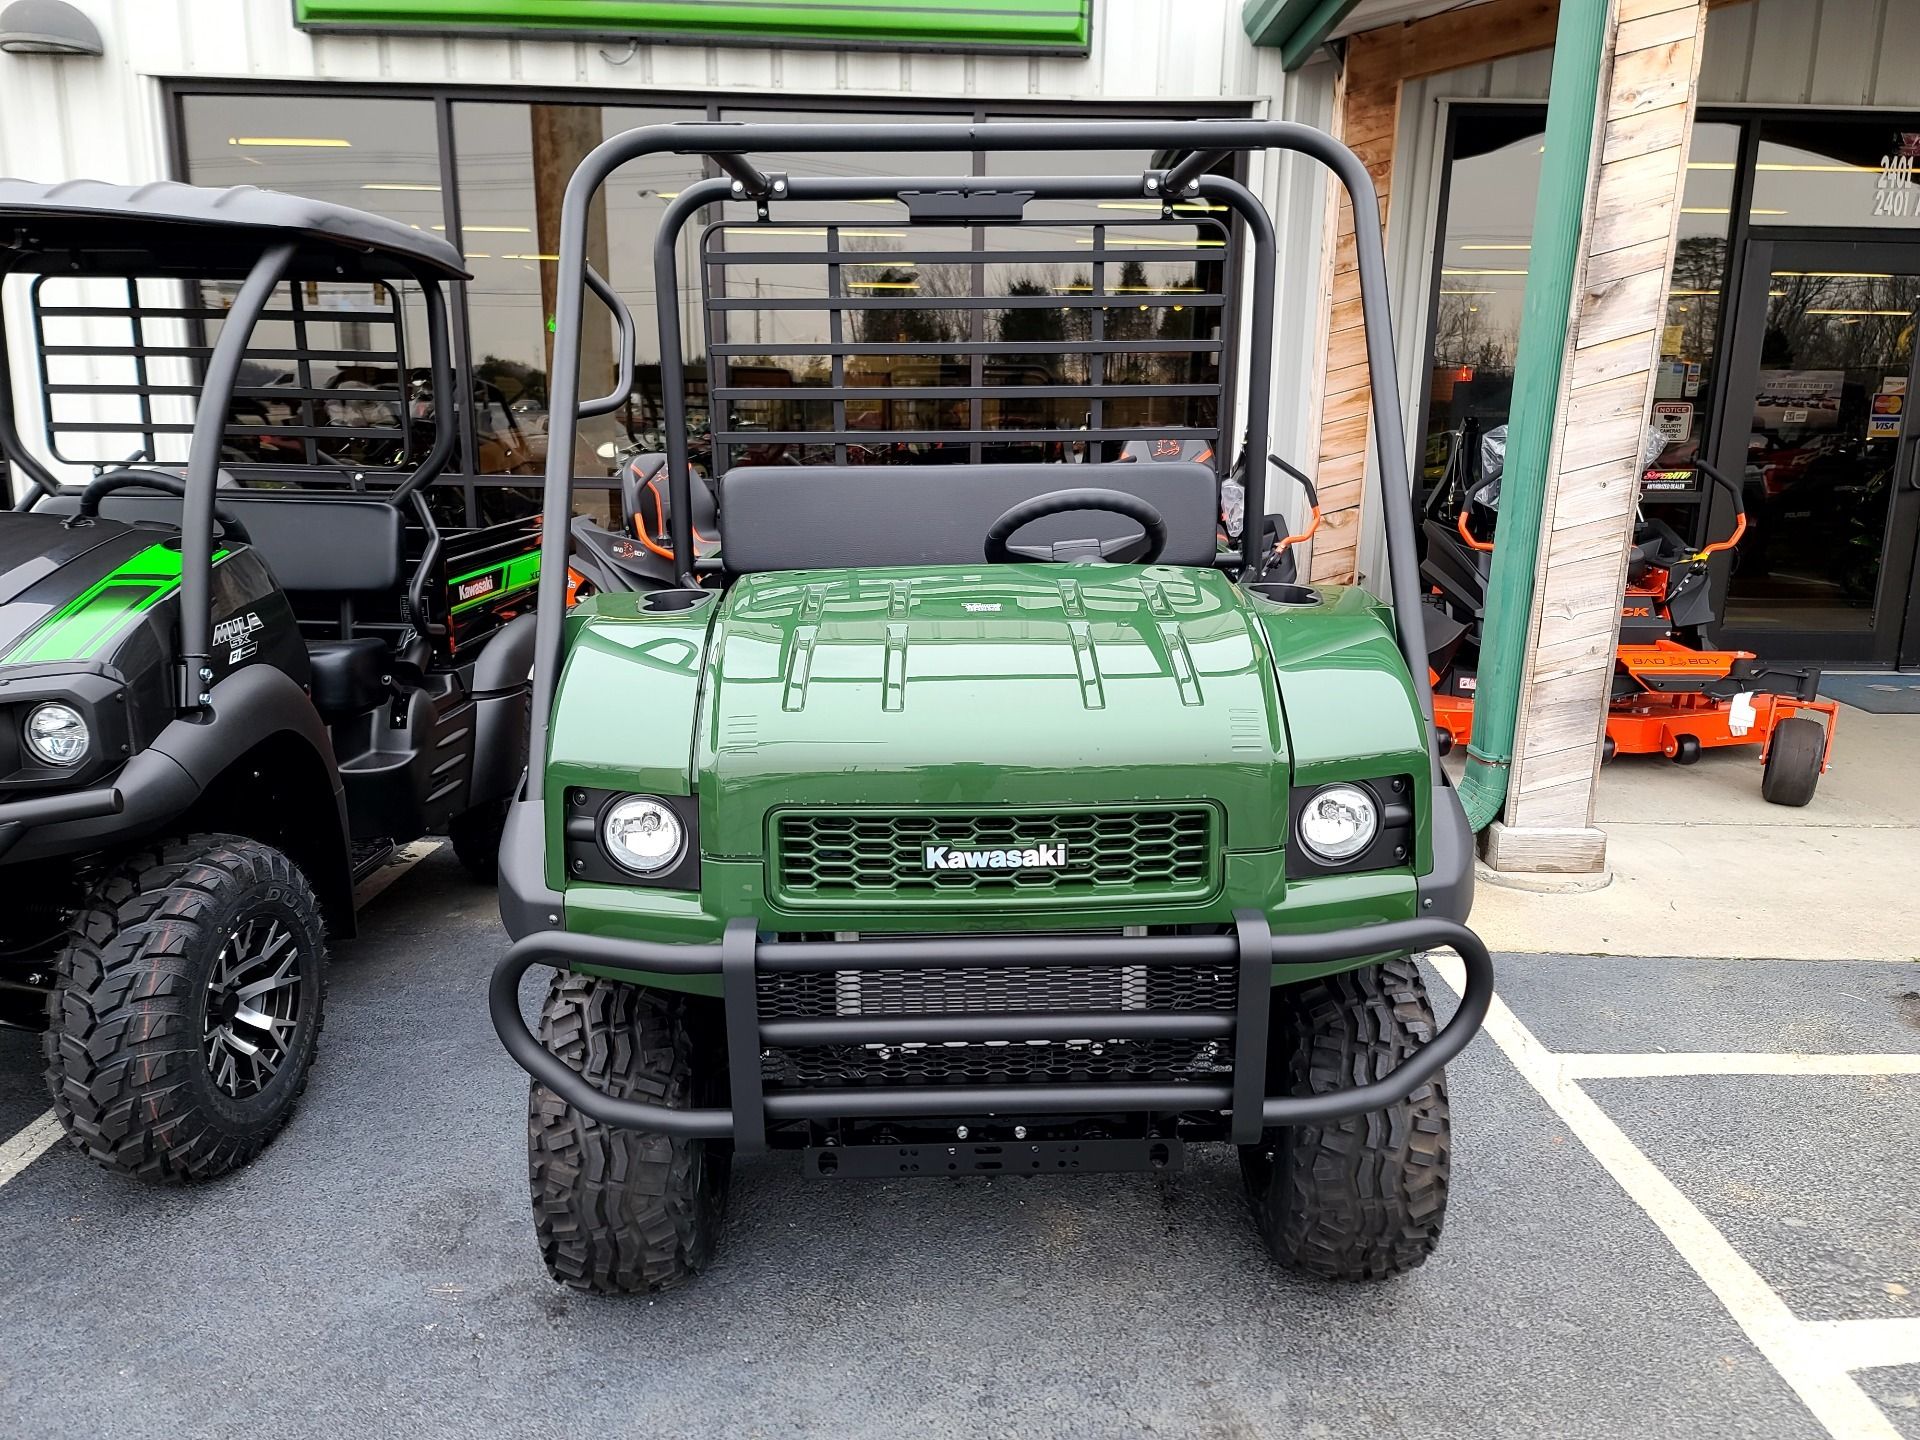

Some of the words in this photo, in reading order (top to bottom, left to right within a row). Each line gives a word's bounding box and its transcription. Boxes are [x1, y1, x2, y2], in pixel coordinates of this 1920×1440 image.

[1878, 155, 1914, 189] 2401
[1874, 190, 1910, 216] 2401
[1875, 422, 1896, 430] VISA
[458, 575, 494, 601] Kawasaki
[212, 612, 265, 647] MULE
[926, 843, 1066, 869] Kawasaki
